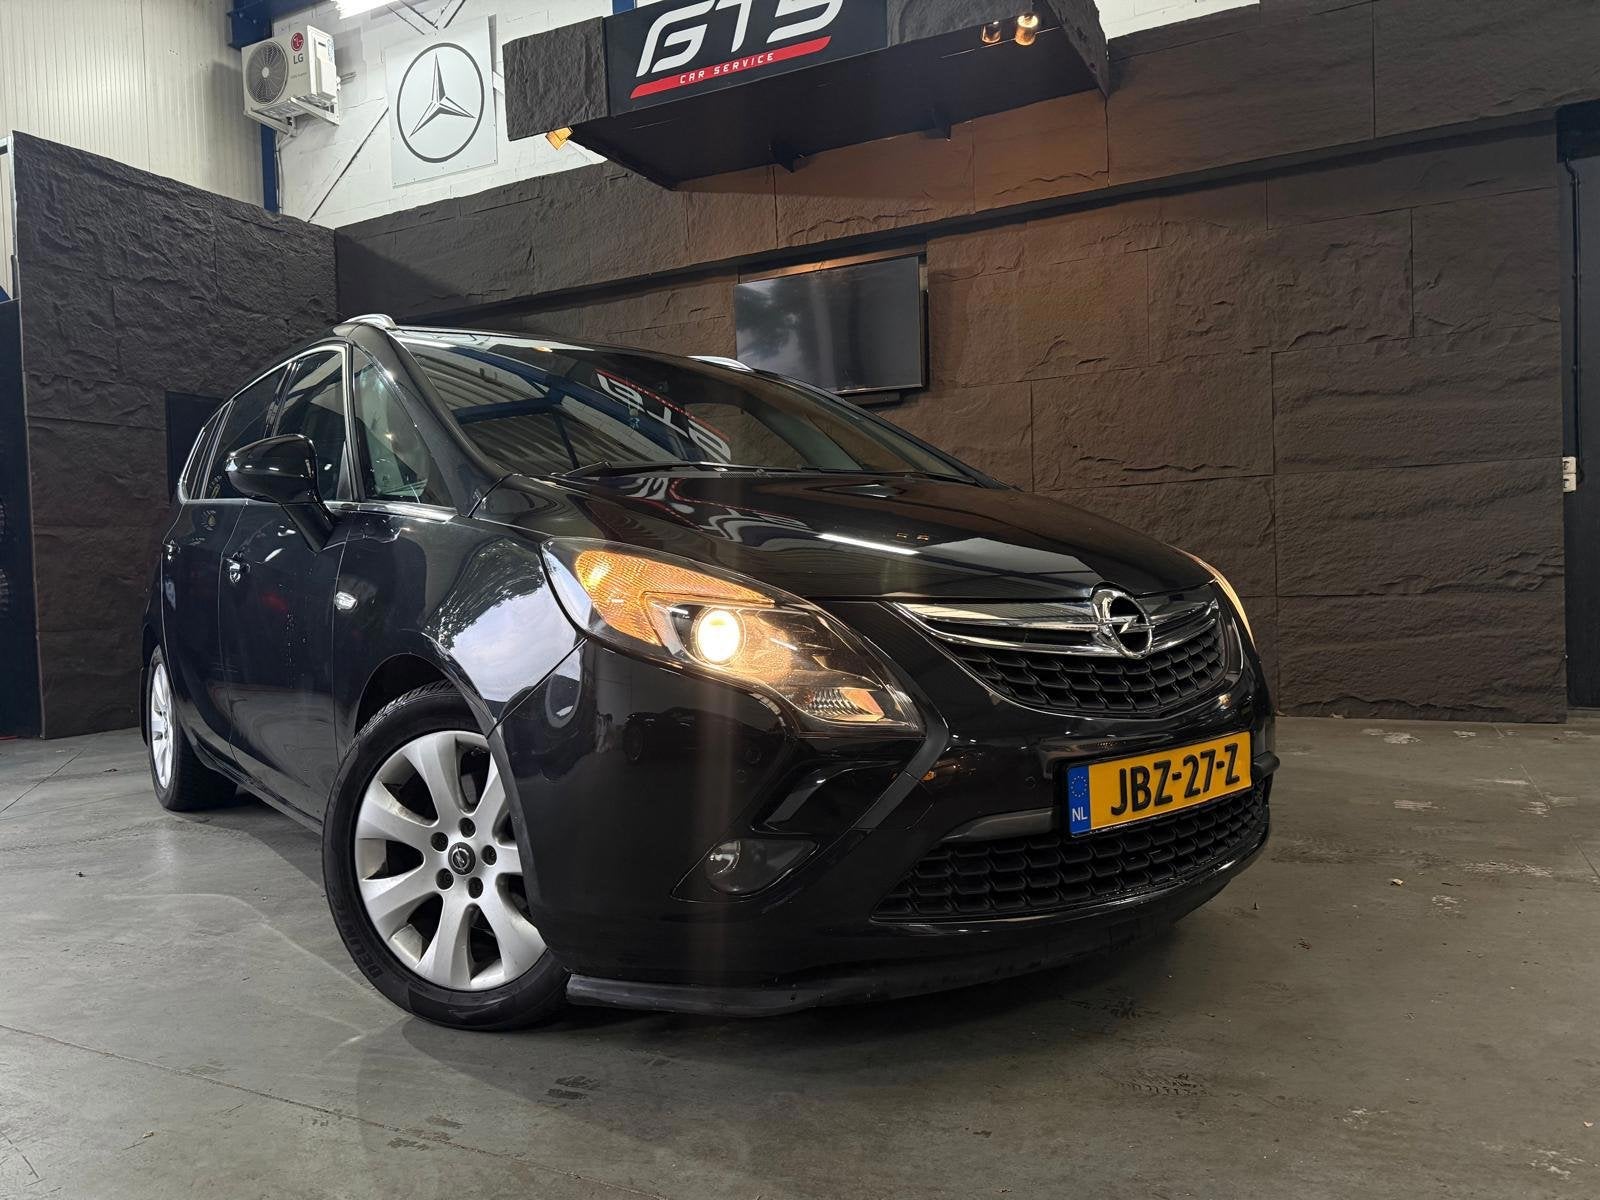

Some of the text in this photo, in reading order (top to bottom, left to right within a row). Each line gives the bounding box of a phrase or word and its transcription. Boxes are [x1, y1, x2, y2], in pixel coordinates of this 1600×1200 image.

[636, 0, 843, 78] GTS
[293, 53, 304, 65] LG
[680, 53, 774, 85] CAR SERVICE
[1111, 743, 1240, 815] JBZ-27-Z
[1072, 806, 1089, 822] NL
